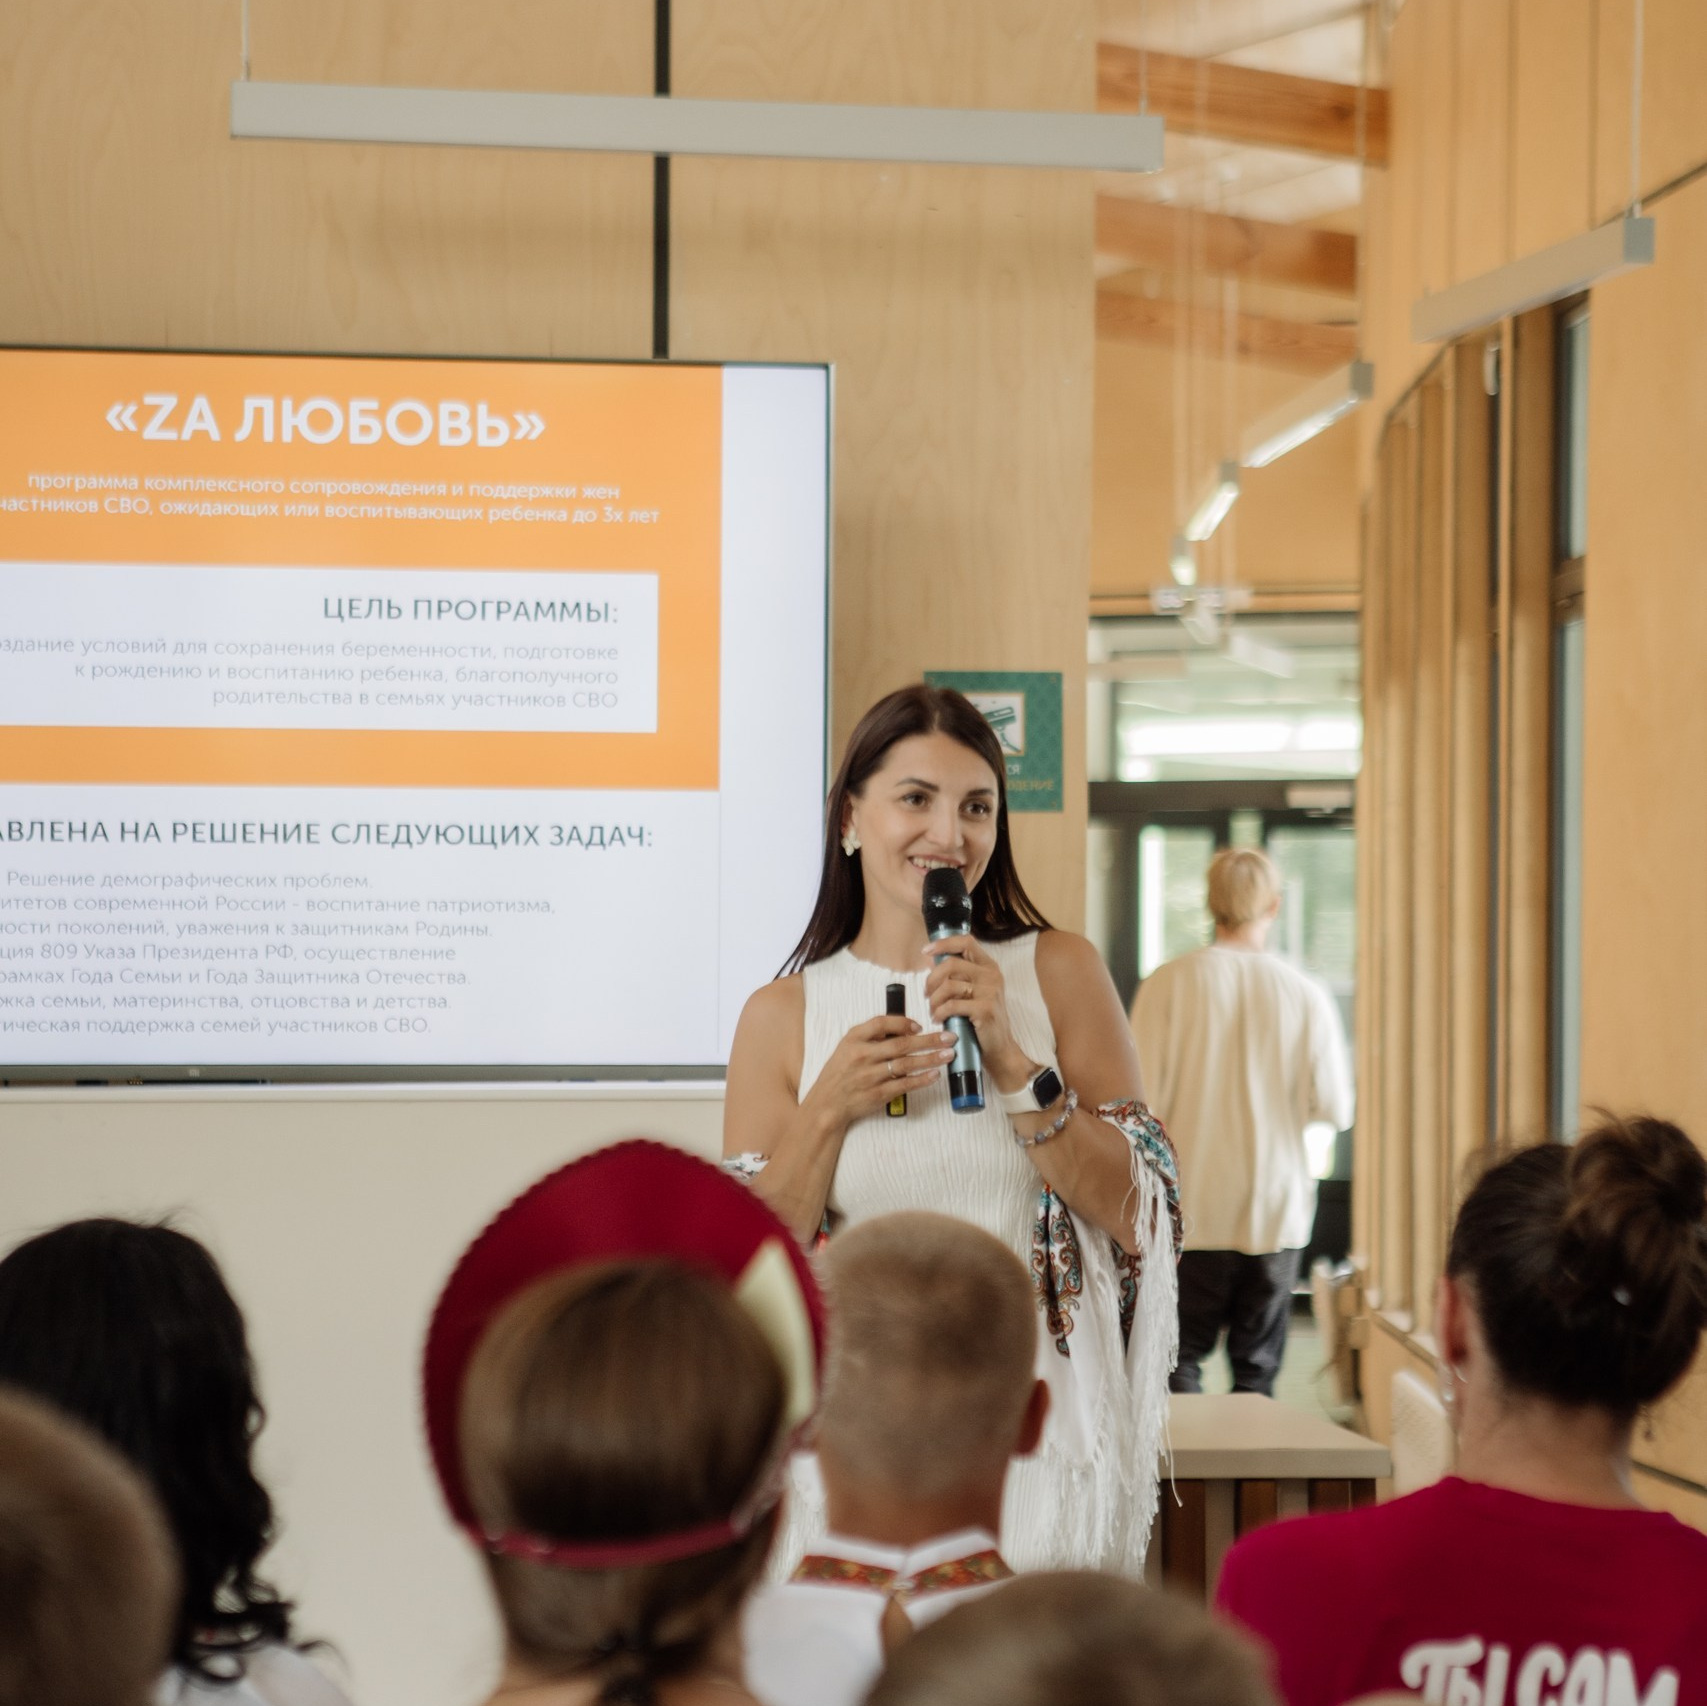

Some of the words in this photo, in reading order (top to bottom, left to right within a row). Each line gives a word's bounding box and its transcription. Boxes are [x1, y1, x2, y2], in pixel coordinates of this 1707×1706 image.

[234, 396, 545, 447] ЛЮБОВЬ»
[28, 474, 139, 492] программа
[144, 477, 285, 493] комплексного
[289, 480, 447, 497] сопровождения
[451, 484, 464, 496] и
[469, 484, 577, 501] поддержки
[583, 486, 620, 499] жен
[0, 496, 99, 513] частников
[104, 496, 153, 515] СВО,
[160, 501, 279, 517] ожидающих
[284, 502, 320, 516] или
[324, 503, 483, 521] воспитывающих
[488, 505, 568, 523] ребенка
[572, 508, 598, 523] до
[603, 505, 623, 522] 3х
[628, 509, 659, 523] лет
[324, 598, 402, 622] ЦЕЛЬ
[413, 599, 619, 622] ПРОГРАММЫ:
[0, 638, 74, 653] здание
[81, 638, 166, 657] условий
[173, 642, 207, 656] для
[214, 642, 334, 658] сохранения
[341, 641, 496, 660] беременности,
[504, 646, 618, 660] подготовке
[75, 665, 84, 677] к
[92, 665, 201, 681] рождению
[209, 667, 220, 678] и
[227, 667, 354, 680] воспитанию
[361, 666, 447, 684] ребенка,
[456, 666, 618, 687] благополучного
[213, 691, 352, 707] родительства
[360, 692, 369, 705] в
[376, 693, 445, 705] семьях
[452, 693, 566, 710] участников
[573, 691, 618, 708] СВО
[0, 821, 109, 842] ВЛЕНА
[121, 822, 160, 842] НА
[173, 822, 319, 843] РЕШЕНИЕ
[331, 824, 539, 849] СЛЕДУЮЩИХ
[550, 825, 651, 850] ЗАДАЧ:
[8, 871, 95, 886] Решение
[100, 872, 277, 890] демографических
[284, 873, 372, 891] проблем.
[0, 898, 67, 910] итетов
[74, 896, 207, 914] современной
[216, 895, 285, 911] России
[306, 899, 420, 912] воспитание
[427, 900, 555, 915] патриотизма,
[58, 920, 169, 936] поколений,
[176, 923, 269, 939] уважения
[276, 924, 284, 935] к
[291, 923, 408, 937] защитникам
[416, 921, 492, 938] Родины.
[41, 942, 77, 959] 809
[84, 944, 135, 959] Указа
[143, 943, 258, 963] Президента
[265, 944, 296, 960] РФ,
[304, 947, 456, 964] осуществление
[72, 968, 113, 985] Года
[120, 968, 181, 983] Семьи
[189, 972, 199, 983] и
[207, 969, 247, 985] Года
[255, 968, 359, 985] Защитника
[366, 968, 470, 984] Отечества.
[42, 996, 105, 1010] семьи,
[113, 996, 243, 1011] материнства,
[251, 996, 350, 1010] отцовства
[357, 997, 367, 1008] и
[373, 997, 451, 1010] детства.
[87, 1021, 194, 1036] поддержка
[201, 1017, 260, 1033] семей
[268, 1020, 378, 1036] участников
[384, 1017, 431, 1033] СВО.
